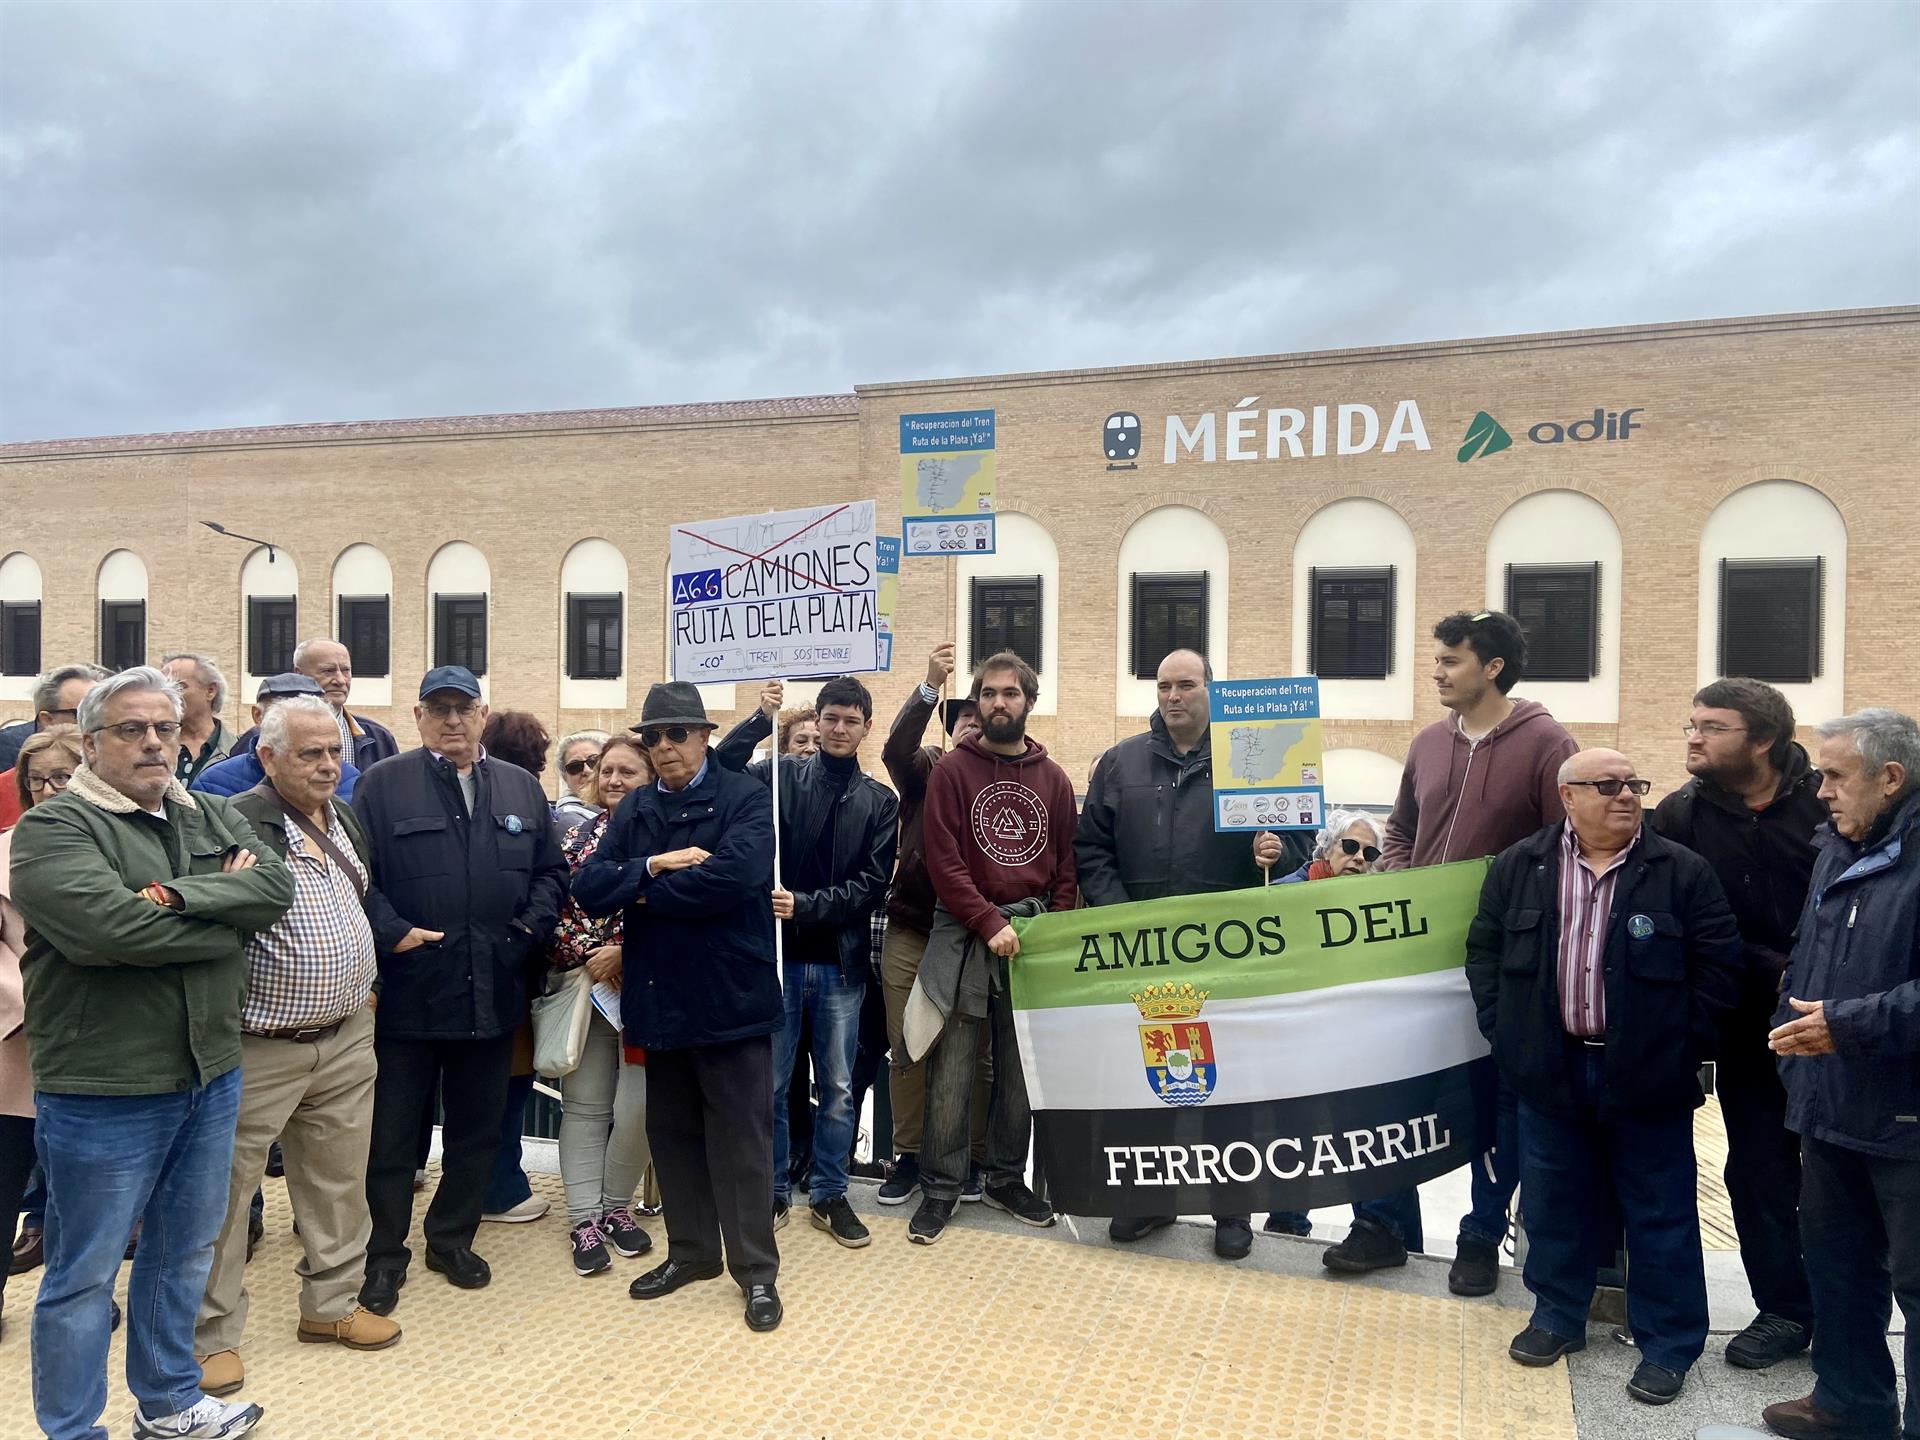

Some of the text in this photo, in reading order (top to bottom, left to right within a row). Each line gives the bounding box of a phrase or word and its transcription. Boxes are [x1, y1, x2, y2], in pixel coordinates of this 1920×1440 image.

[962, 418, 972, 428] del
[975, 417, 990, 426] Tren
[1163, 396, 1431, 464] MÉRIDA
[1528, 408, 1644, 445] adif
[912, 437, 928, 446] Ruta
[931, 436, 939, 445] de
[942, 436, 948, 445] la
[950, 435, 968, 445] Plata
[879, 541, 895, 552] Tren
[725, 541, 871, 599] CAMIONES
[676, 607, 735, 646] RUTA
[808, 592, 874, 634] PLATA
[749, 649, 778, 662] TREN
[1279, 684, 1292, 696] del
[1294, 684, 1313, 694] Tren
[1224, 704, 1242, 714] Ruta
[1245, 704, 1254, 714] de
[1257, 703, 1264, 713] la
[1267, 703, 1287, 712] Plata
[1074, 898, 1429, 973] AMIGOS DEL
[1104, 1112, 1451, 1187] FERROCARRIL
